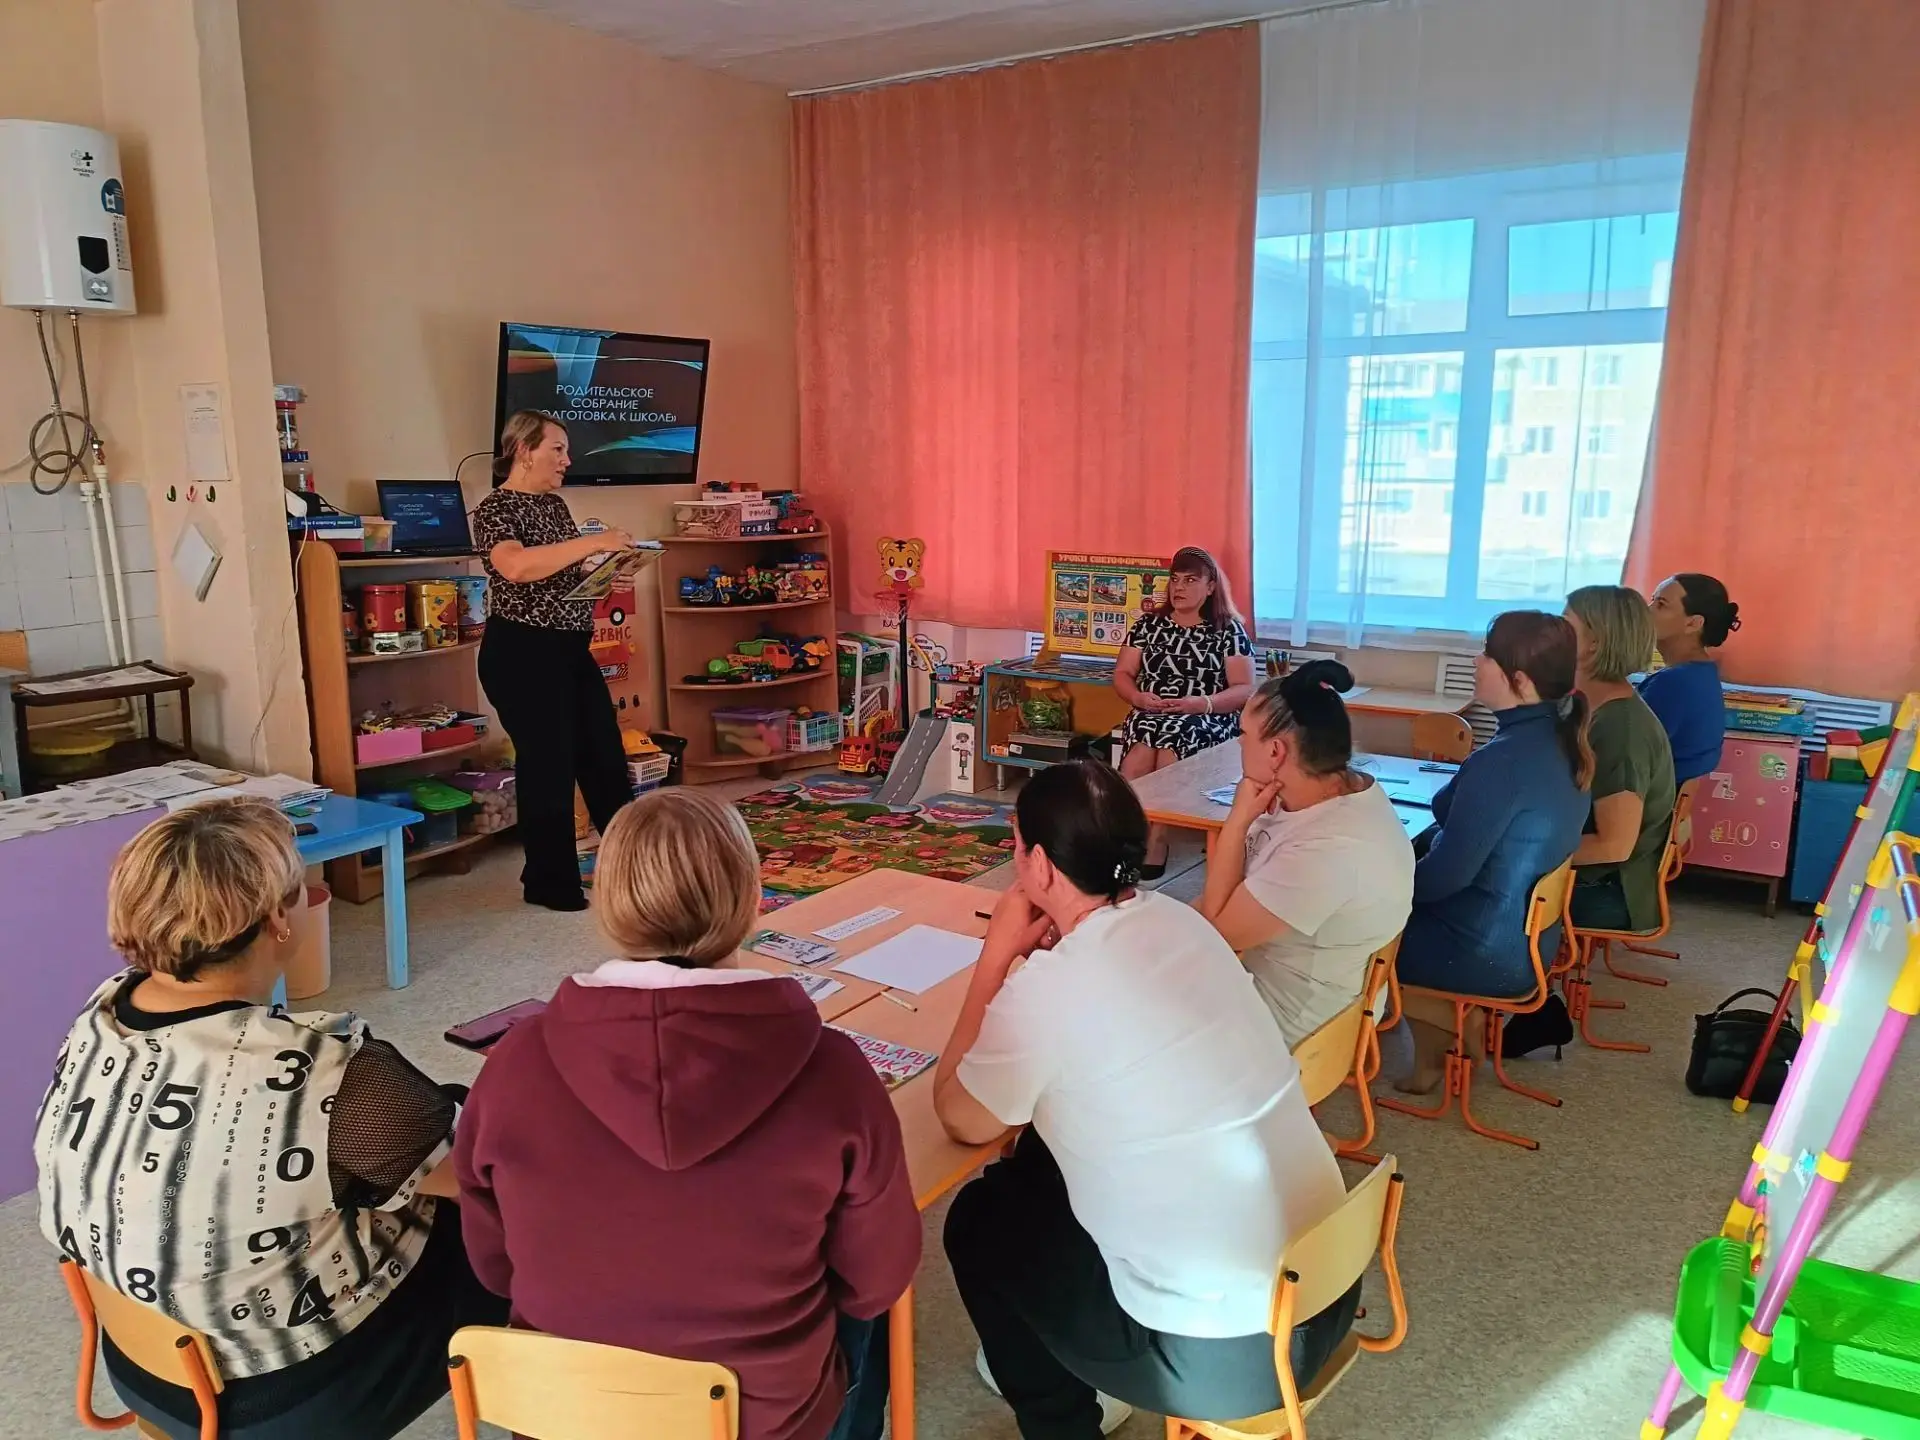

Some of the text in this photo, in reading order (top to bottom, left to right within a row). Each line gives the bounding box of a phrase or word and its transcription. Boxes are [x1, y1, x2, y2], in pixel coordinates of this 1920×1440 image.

[556, 384, 654, 398] РОДИТЕЛЬСКОЕ
[570, 398, 639, 410] СОБРАНИЕ
[619, 411, 627, 421] К
[629, 411, 677, 423] ШКОЛЕ»
[593, 626, 632, 643] ЕРВИС
[78, 1041, 87, 1054] 5
[854, 1036, 929, 1065] ЕНДАРЬ
[68, 1062, 76, 1075] 3
[101, 1056, 115, 1076] 9
[141, 1061, 159, 1082] 3
[265, 1049, 314, 1092] 3
[52, 1105, 60, 1118] 2
[128, 1092, 143, 1115] 9
[147, 1082, 200, 1131] 5
[320, 1094, 337, 1114] 6
[69, 1096, 96, 1152] 1
[225, 1145, 233, 1153] 2
[256, 1101, 276, 1214] 0 8 6 5 2 8 0 2 6 5
[141, 1151, 161, 1173] 5
[275, 1145, 315, 1182] 0
[119, 1173, 125, 1182] 6
[176, 1171, 187, 1182] 2
[166, 1185, 176, 1196] 3
[89, 1223, 101, 1244] 5
[158, 1234, 168, 1244] 9
[205, 1241, 213, 1249] 0
[331, 1250, 343, 1264] 5
[387, 1260, 402, 1279] 6
[126, 1266, 158, 1304] 8
[257, 1287, 277, 1318] 2 5
[286, 1274, 336, 1328] 4
[230, 1303, 251, 1321] 6
